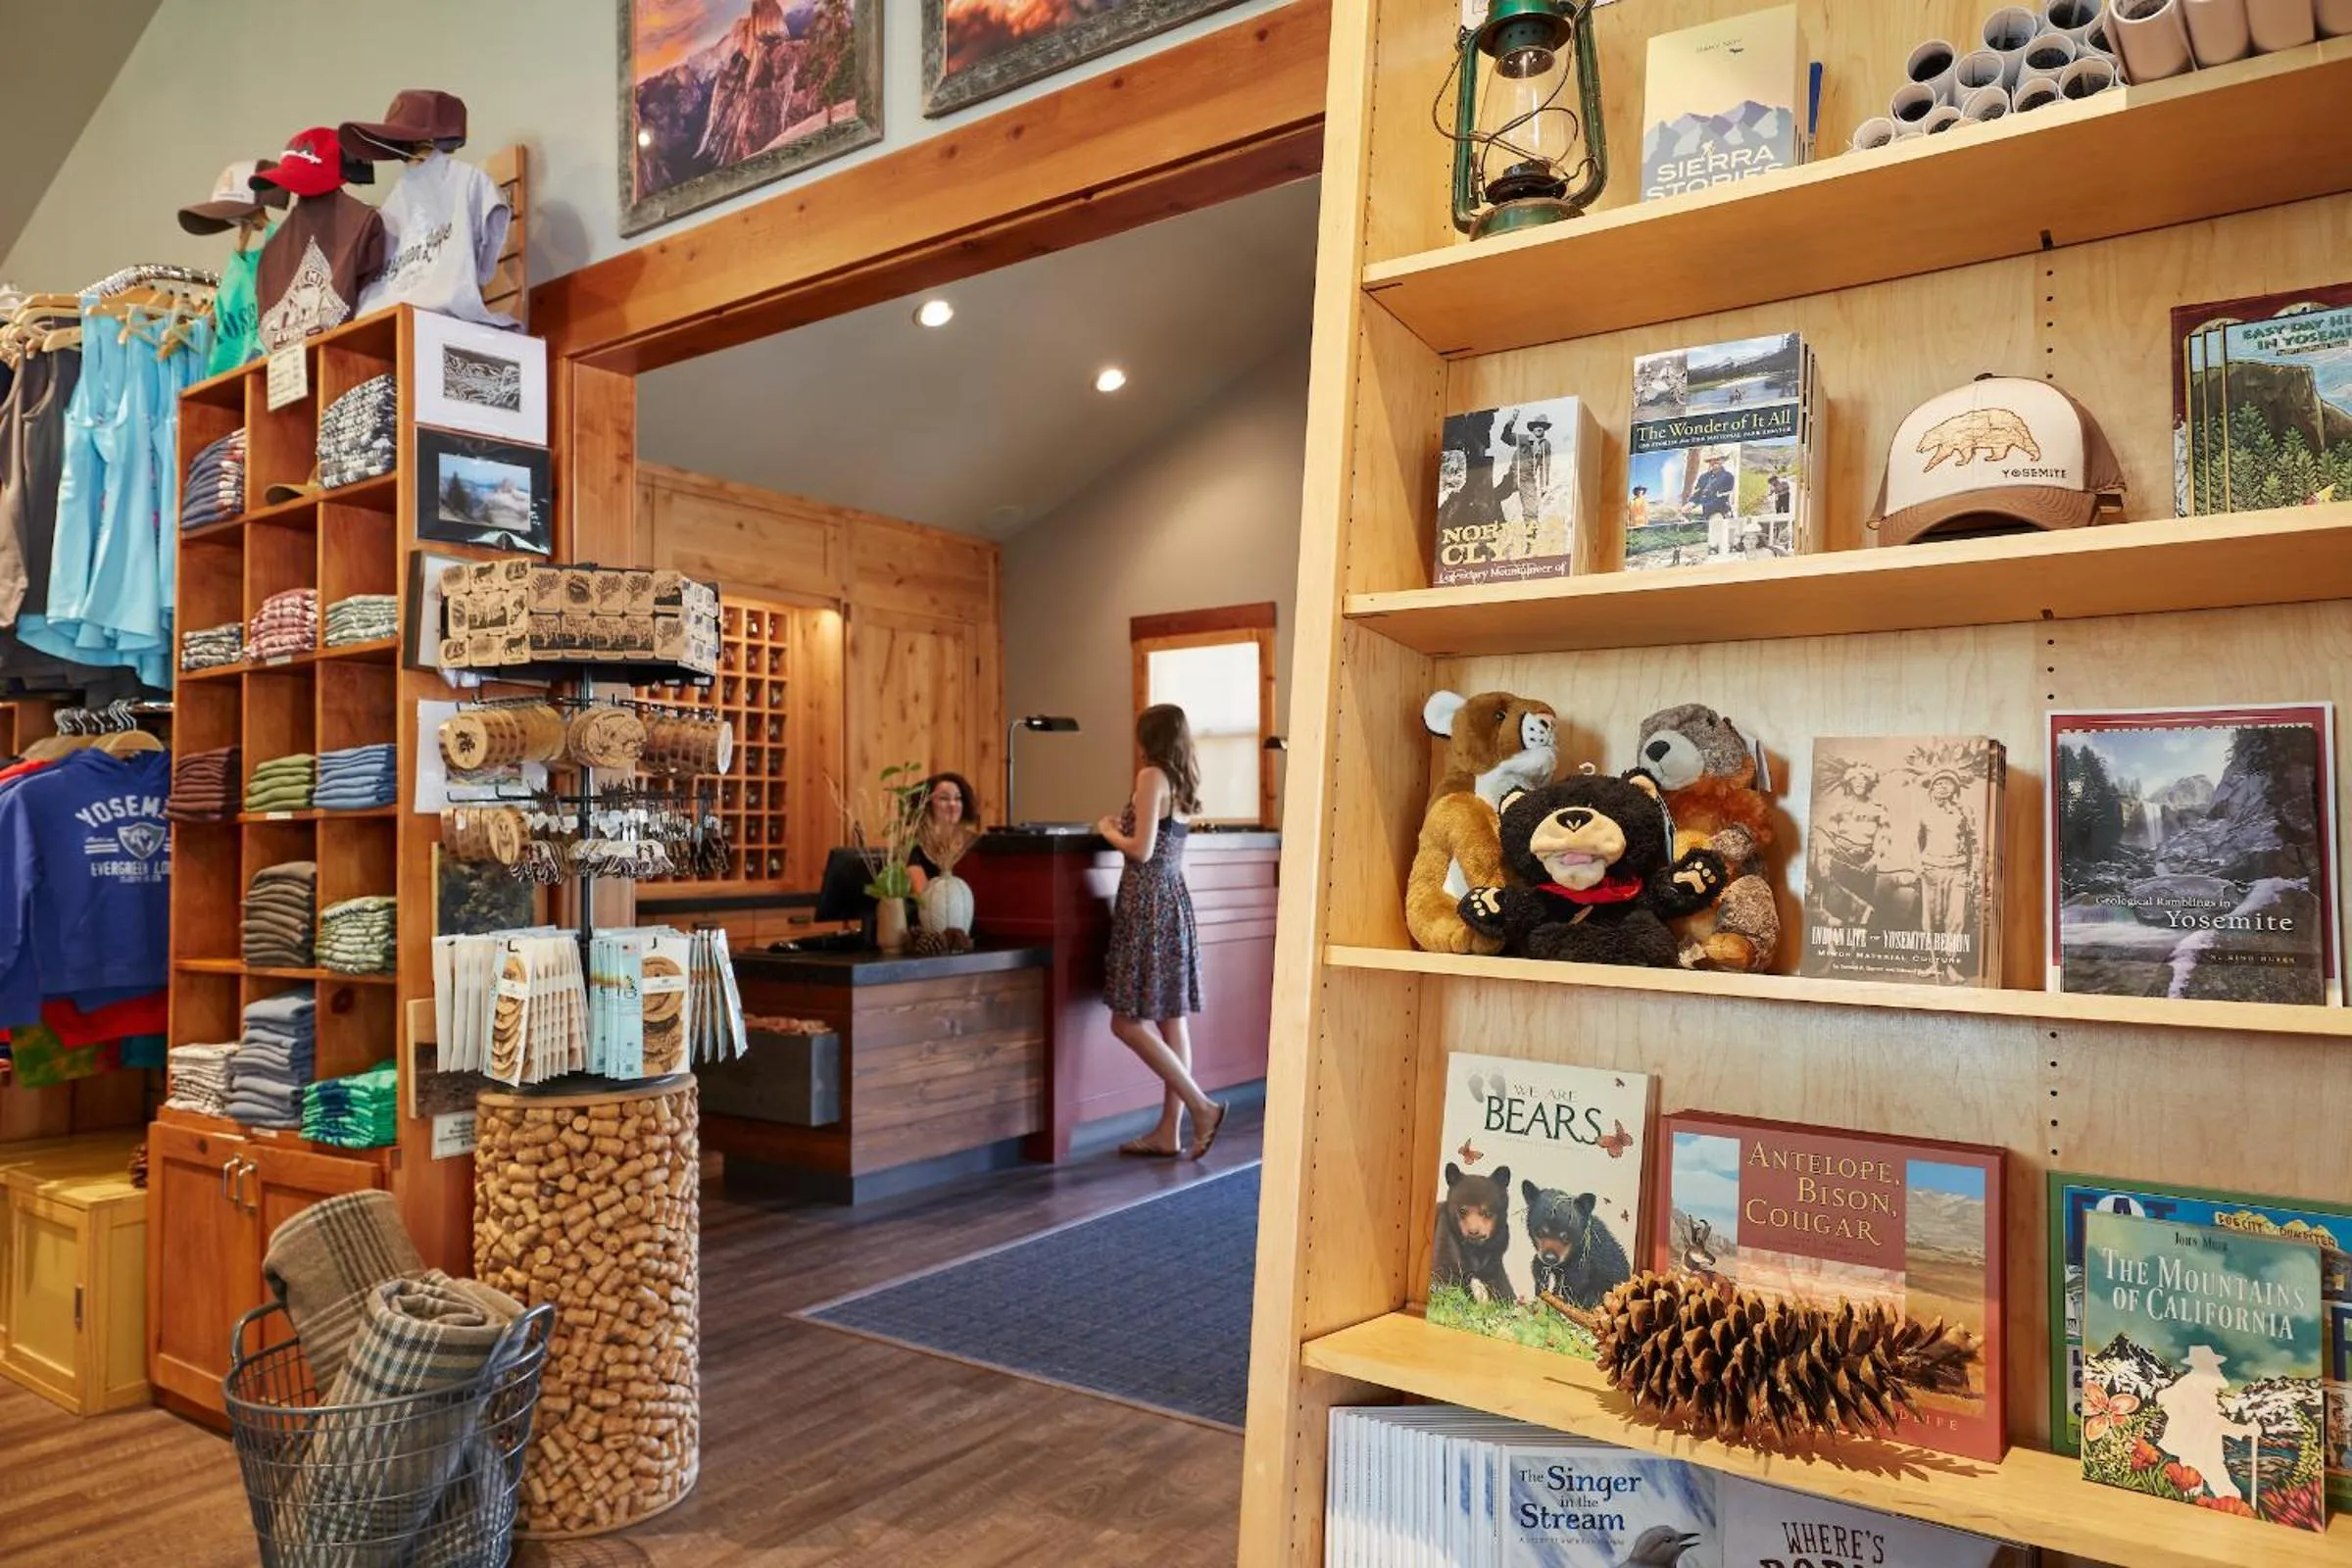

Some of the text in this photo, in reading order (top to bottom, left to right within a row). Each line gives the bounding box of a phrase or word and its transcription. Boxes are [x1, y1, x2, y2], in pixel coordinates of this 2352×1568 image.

[1656, 144, 1775, 183] SIERRA
[1636, 408, 1792, 442] The Wonder of It All
[2001, 467, 2068, 480] YOSEMITE
[1554, 561, 1568, 576] of
[74, 795, 163, 828] YOSEM
[2095, 895, 2231, 908] Geological Ramblings in
[2166, 909, 2294, 931] Yosemite
[1513, 1083, 1579, 1102] WE ARE
[1484, 1095, 1603, 1146] BEARS
[1747, 1140, 1900, 1186] ANTELOPE,
[1796, 1176, 1897, 1218] BISON,
[1745, 1198, 1883, 1247] COUGAR
[2101, 1246, 2306, 1311] THE MOUNTAINS
[2112, 1286, 2294, 1342] OF CALIFORNIA
[1519, 1464, 1643, 1501] The Singer
[1519, 1502, 1626, 1532] Stream
[1559, 1494, 1599, 1508] in the
[1781, 1521, 1885, 1565] WHERE'S
